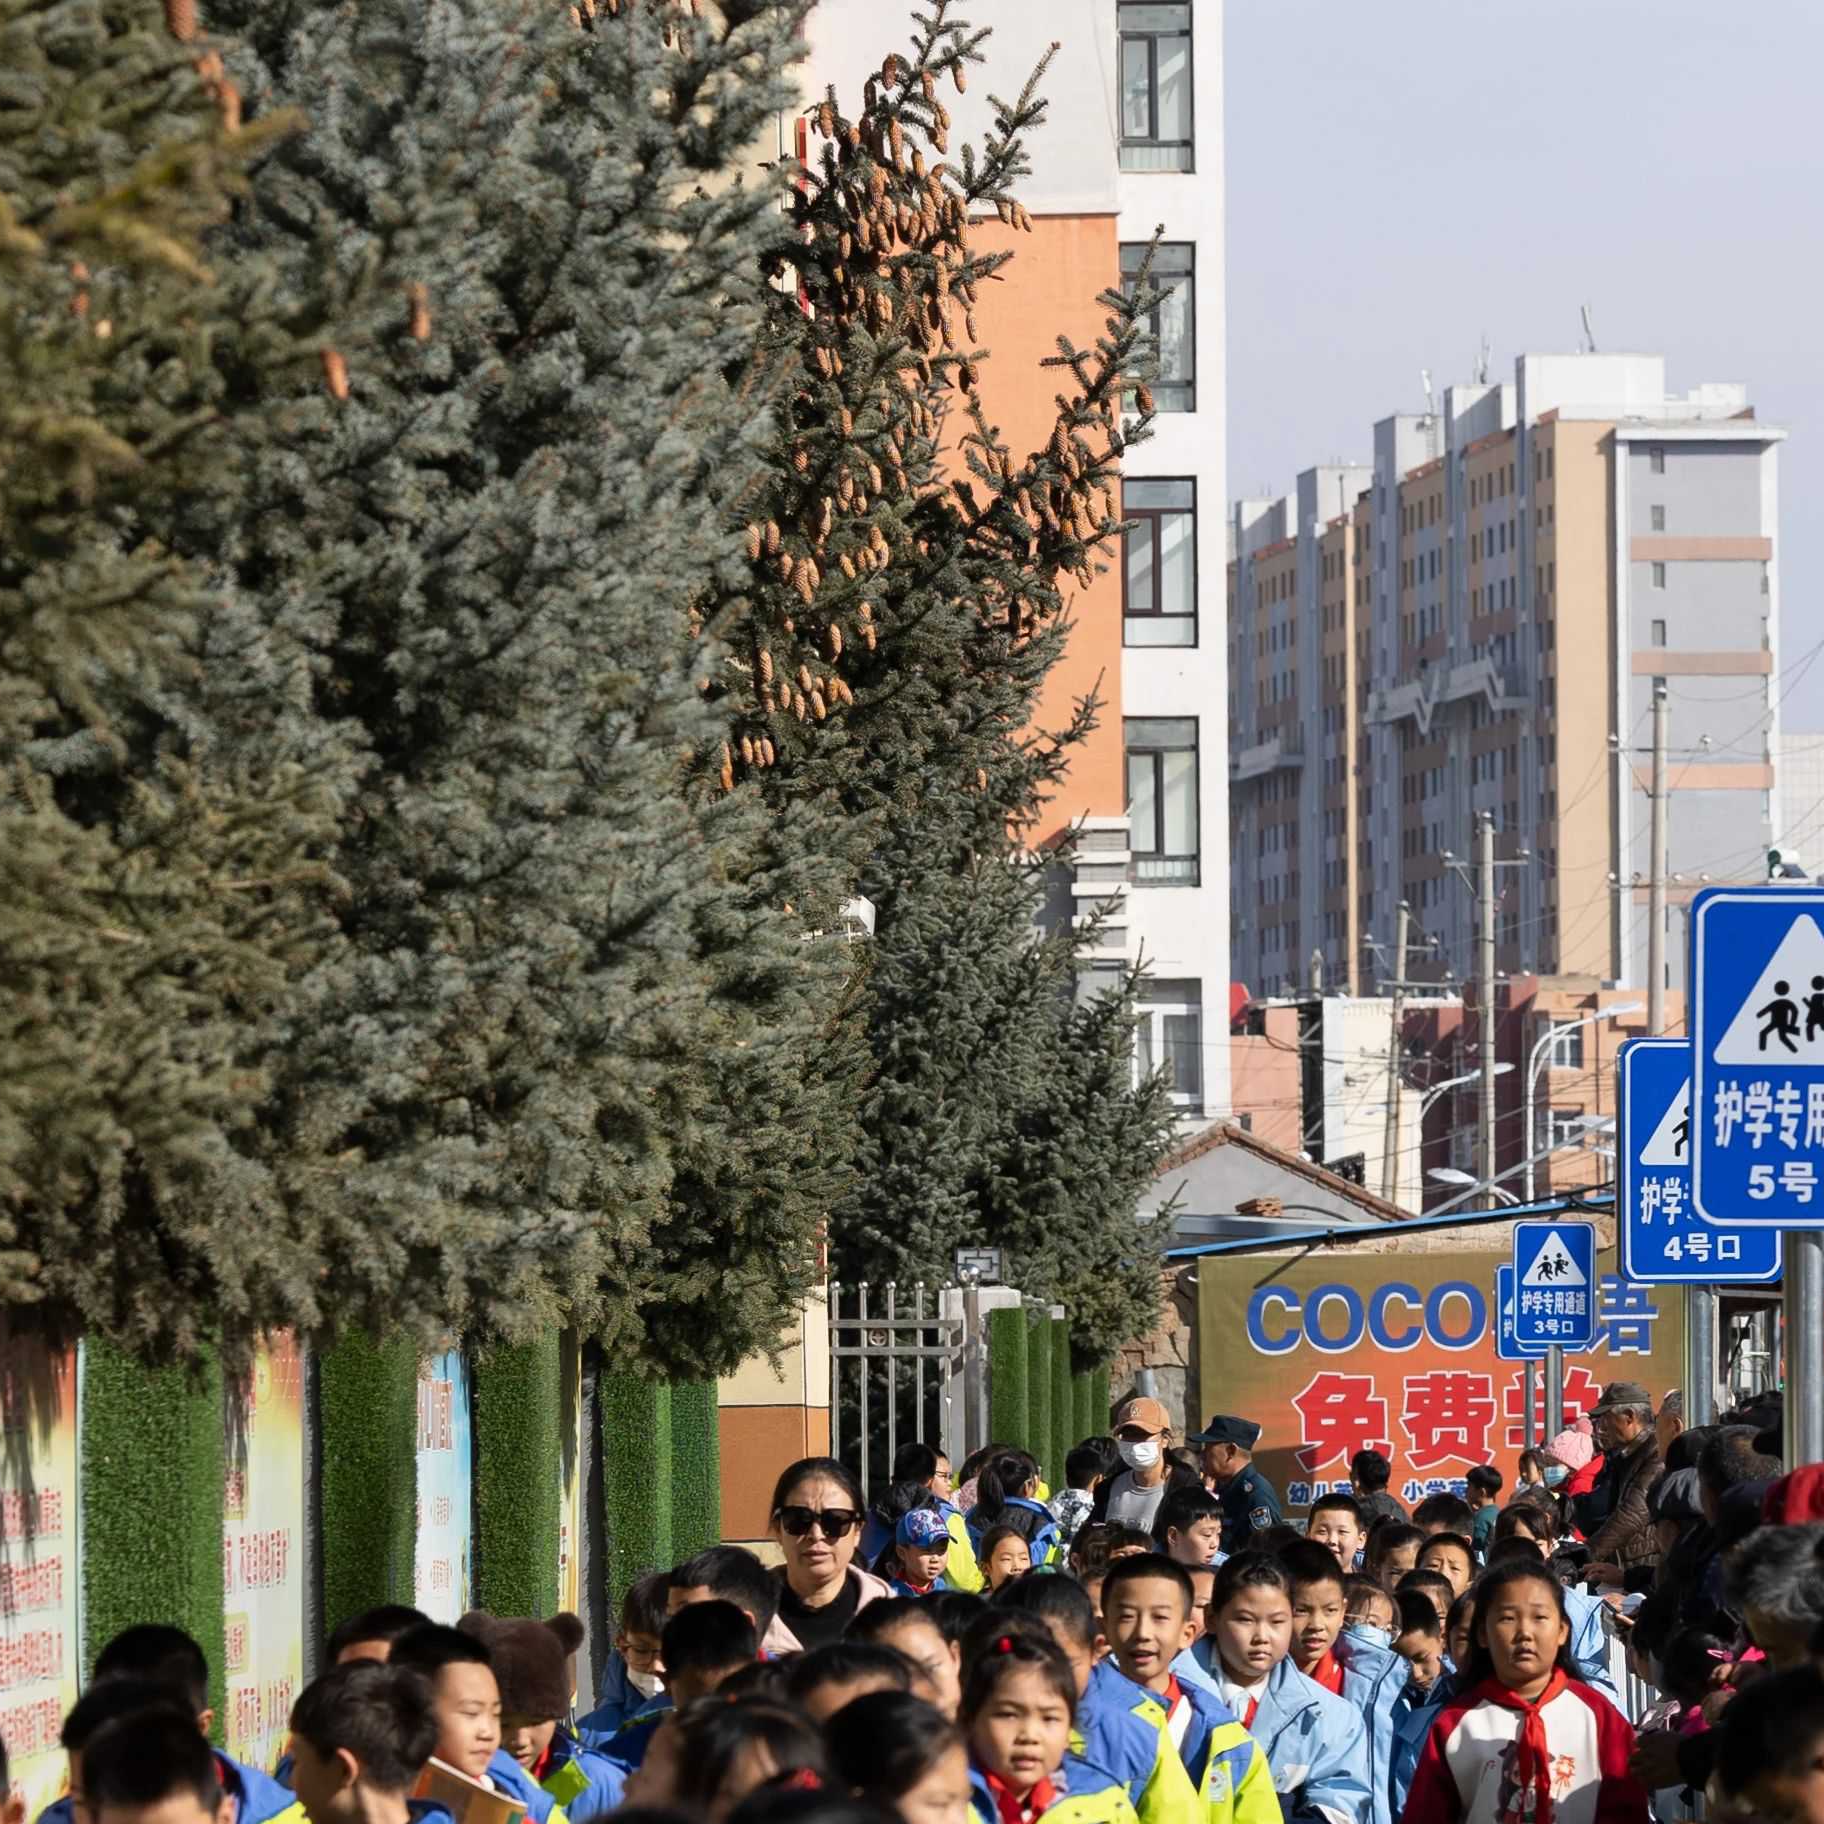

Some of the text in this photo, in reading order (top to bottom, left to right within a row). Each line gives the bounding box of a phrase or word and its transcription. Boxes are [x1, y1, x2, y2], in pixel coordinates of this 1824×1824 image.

[1640, 1177, 1689, 1225] 护学
[1664, 1233, 1740, 1262] 4号口
[1521, 1291, 1586, 1315] 护学专用通道
[1246, 1280, 1488, 1356] COCO
[1534, 1320, 1574, 1335] 3号口
